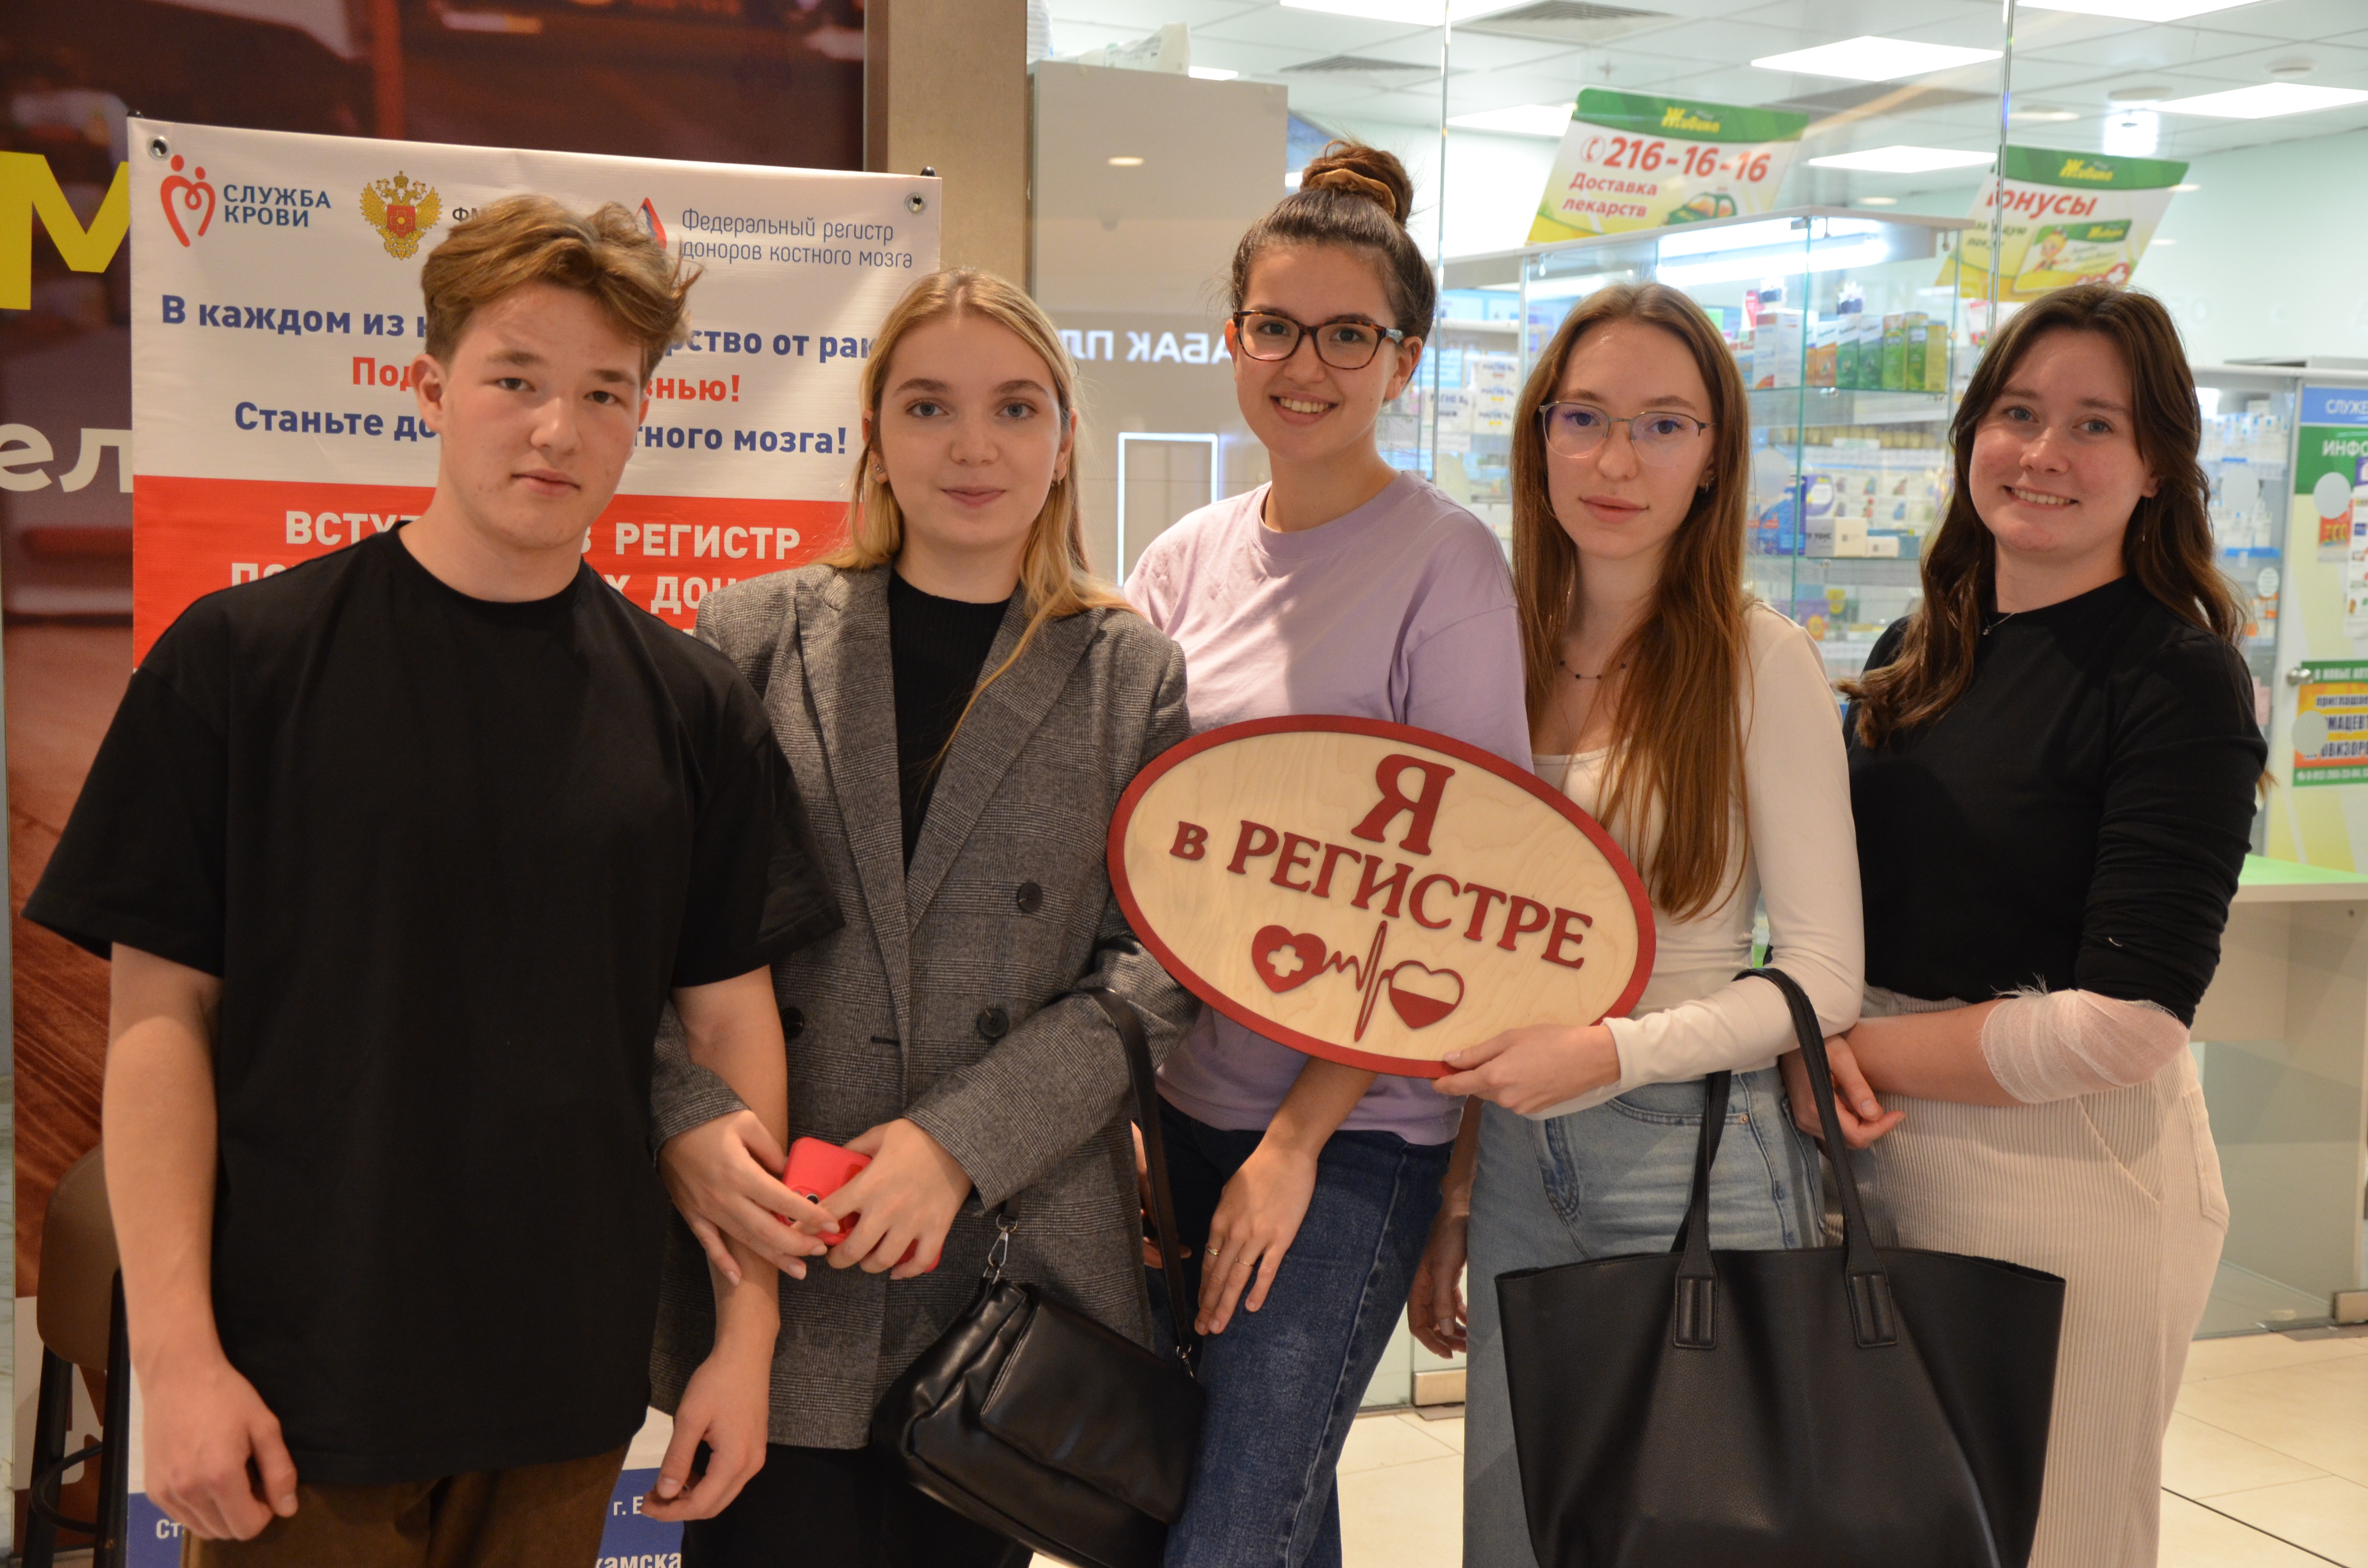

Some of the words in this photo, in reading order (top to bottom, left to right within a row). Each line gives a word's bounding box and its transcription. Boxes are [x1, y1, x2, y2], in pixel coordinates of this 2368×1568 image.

[1603, 136, 1771, 183] 216-16-16
[224, 184, 332, 208] СЛУЖБА
[1569, 172, 1658, 196] Доставка
[225, 205, 309, 228] КРОВИ
[1563, 197, 1647, 218] лекарств
[682, 208, 816, 237] Федеральный
[823, 222, 894, 246] регистр
[682, 241, 763, 264] доноров
[770, 246, 852, 266] костного
[859, 251, 913, 269] мозга
[162, 295, 186, 324] В
[199, 304, 351, 336] каждом
[364, 313, 404, 337] из
[773, 334, 810, 356] от
[235, 402, 384, 436] Станьте
[635, 426, 723, 450] ного
[734, 427, 847, 454] мозга!
[286, 511, 421, 546] ВСТУ
[616, 523, 800, 560] РЕГИСТР
[1351, 754, 1455, 857] Я
[1169, 821, 1209, 861] в
[1226, 819, 1593, 969] РЕГИСТРЕ
[613, 1501, 626, 1516] г.
[157, 1519, 185, 1539] Ст
